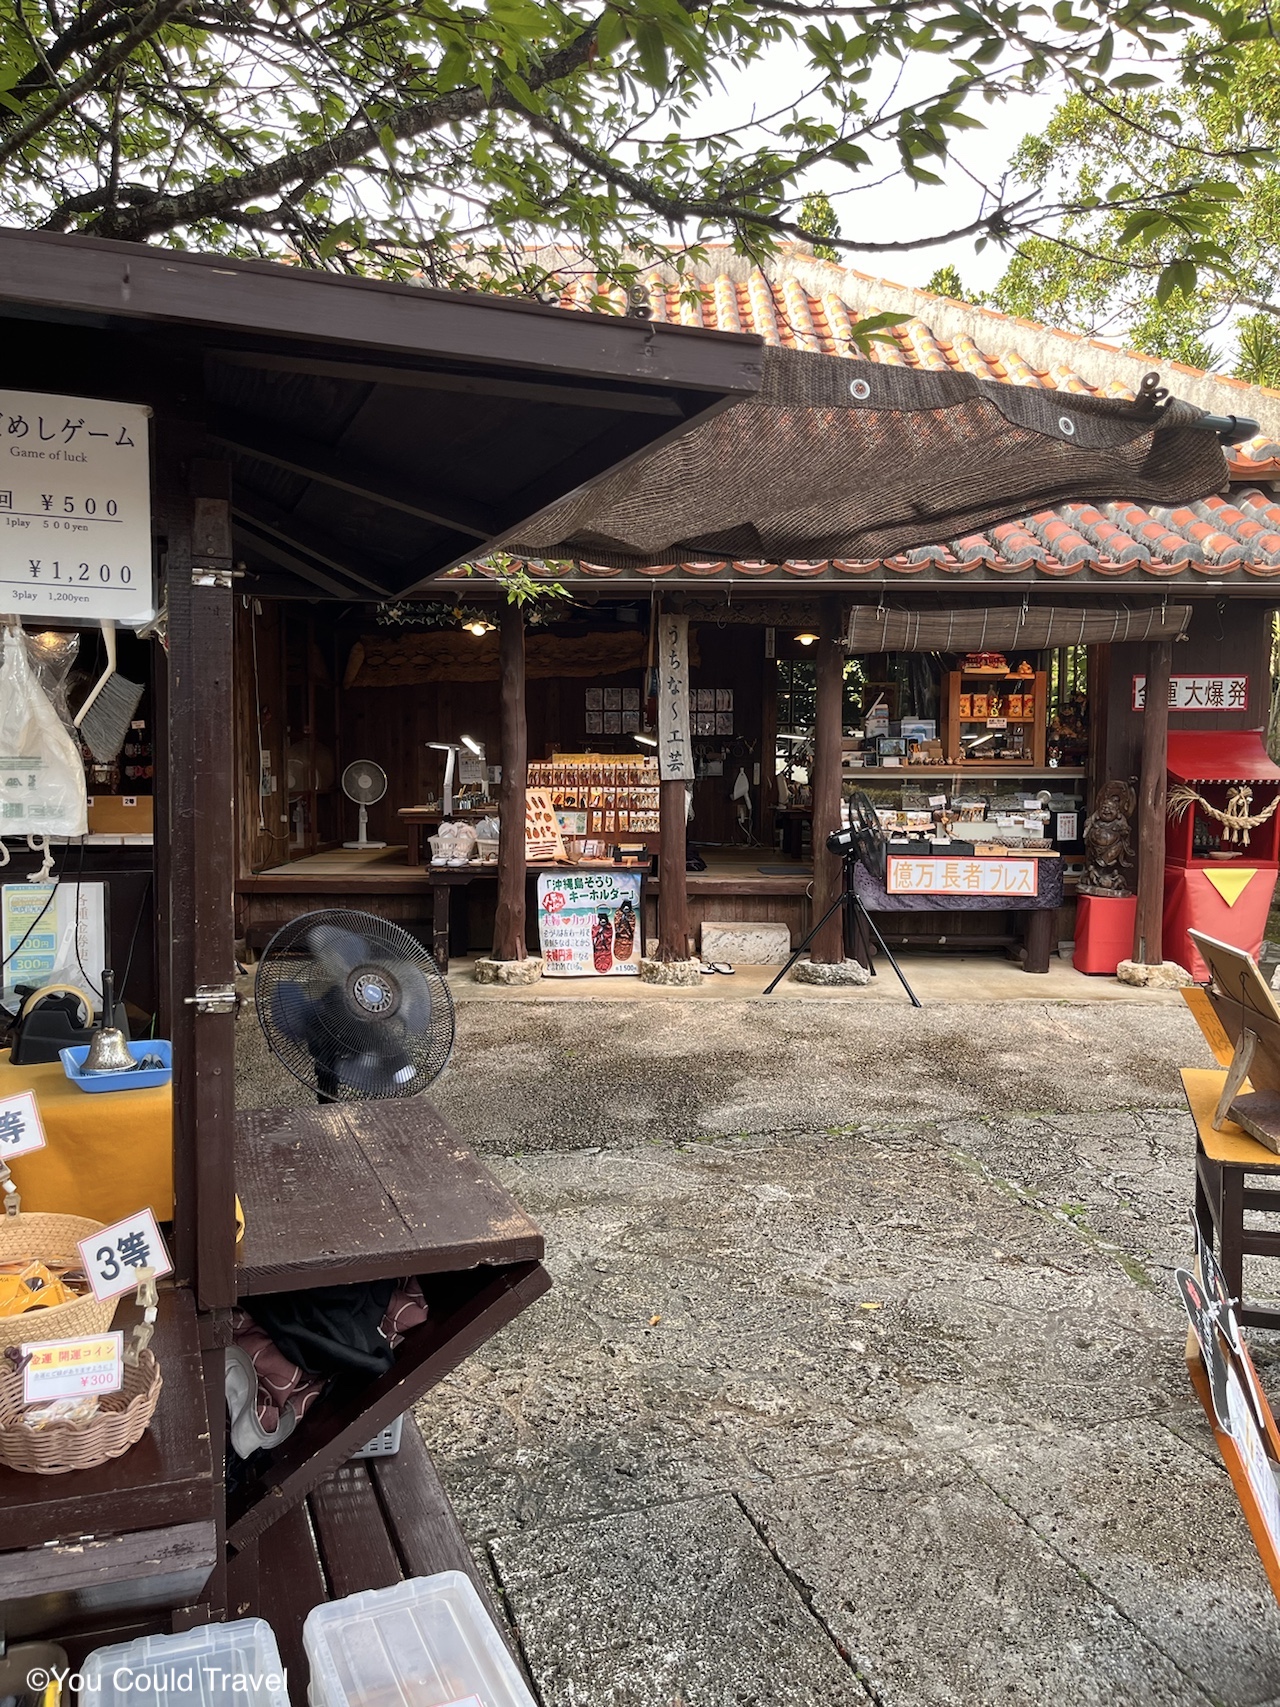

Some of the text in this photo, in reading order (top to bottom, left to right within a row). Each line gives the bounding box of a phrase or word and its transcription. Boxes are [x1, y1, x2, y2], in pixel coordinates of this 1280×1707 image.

[0, 412, 135, 447] めしゲーム
[10, 446, 88, 463] Game of luck
[41, 494, 117, 516] ¥500
[6, 517, 31, 528] 1play
[29, 559, 132, 584] ¥1,200
[12, 590, 38, 601] 3play
[96, 1231, 151, 1281] 3等
[80, 1372, 114, 1387] ¥300
